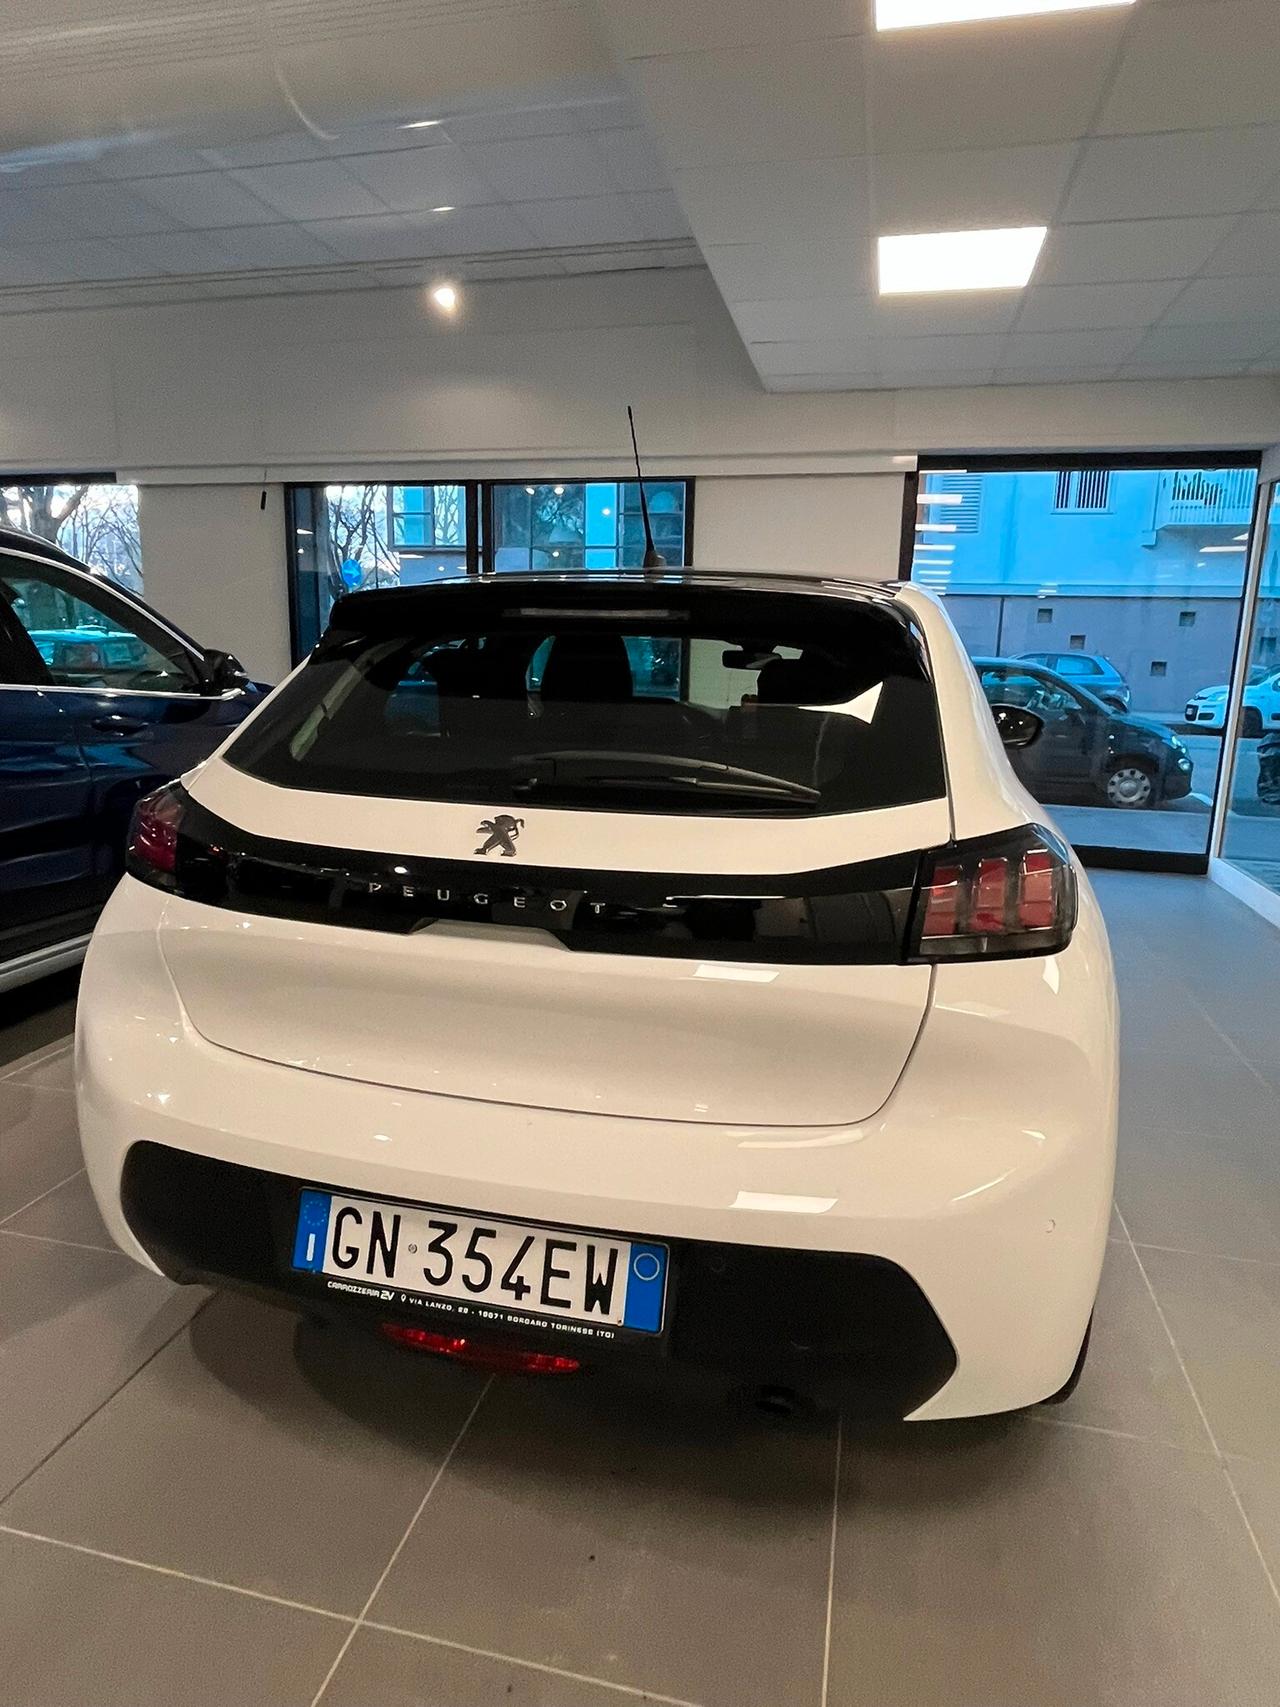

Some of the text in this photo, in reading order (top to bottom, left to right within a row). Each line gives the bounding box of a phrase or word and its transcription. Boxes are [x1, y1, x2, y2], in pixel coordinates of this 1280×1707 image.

[367, 882, 606, 915] PEUGEOT
[331, 1205, 402, 1279] GN
[408, 1297, 424, 1305] VIA
[550, 1322, 594, 1335] TORINESE
